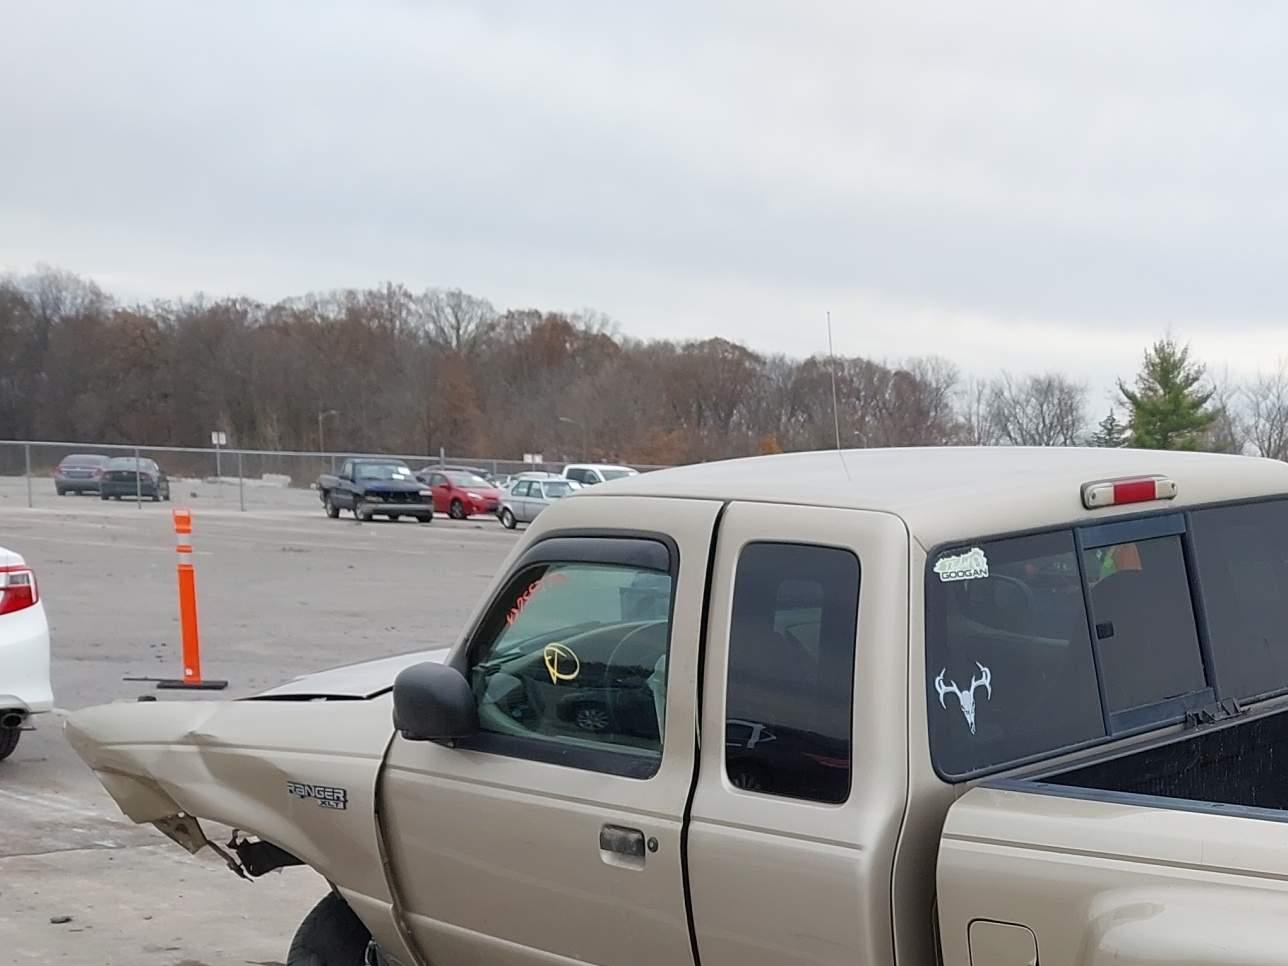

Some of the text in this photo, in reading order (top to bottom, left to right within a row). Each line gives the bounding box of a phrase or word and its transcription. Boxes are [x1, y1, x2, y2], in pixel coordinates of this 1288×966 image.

[942, 569, 987, 579] GOOGAN
[287, 783, 346, 801] RANGER
[319, 800, 345, 810] XLT
